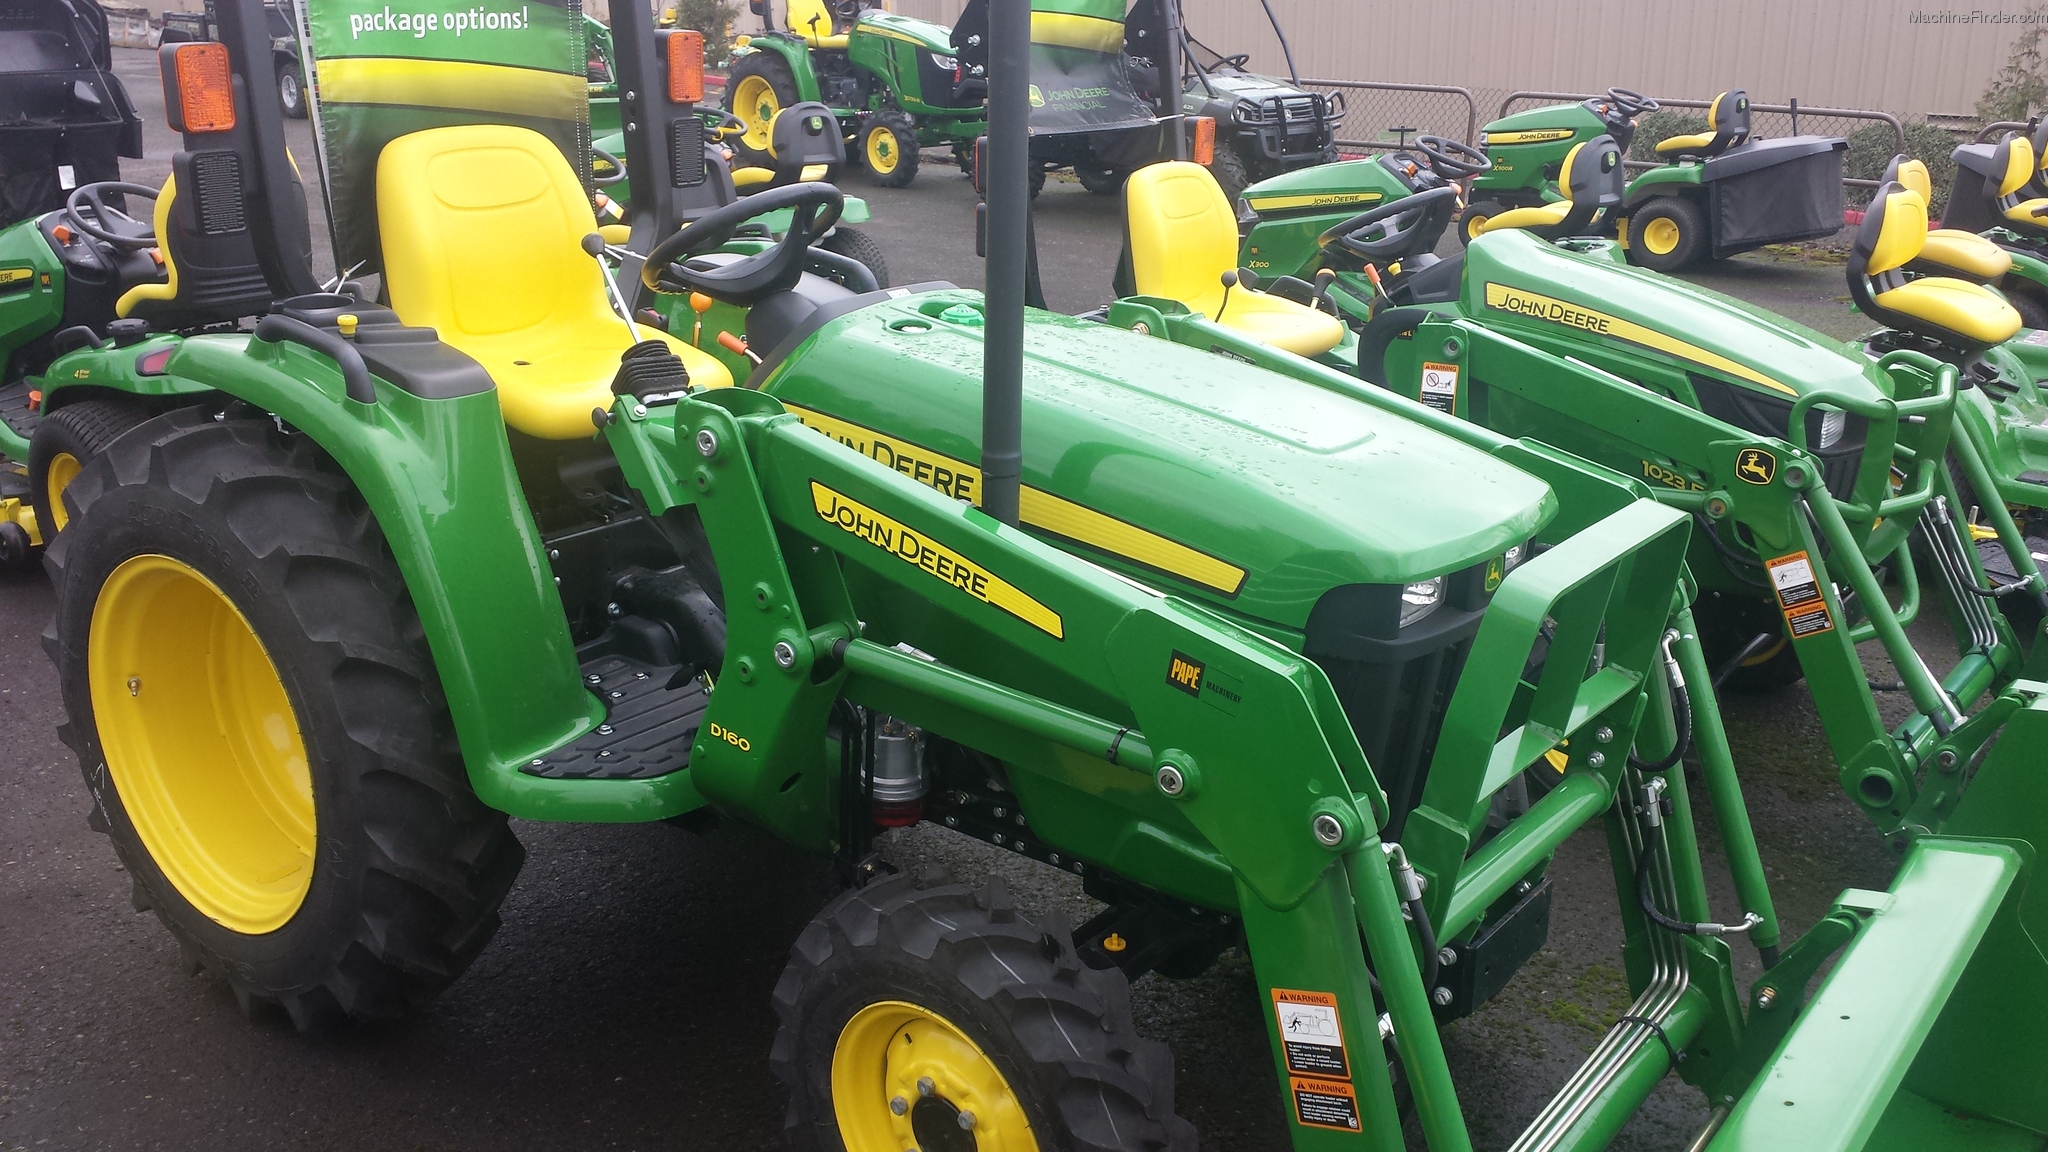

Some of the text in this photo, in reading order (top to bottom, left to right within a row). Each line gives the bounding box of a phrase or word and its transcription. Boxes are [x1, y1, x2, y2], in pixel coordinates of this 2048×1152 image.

[350, 5, 529, 40] package options!
[1048, 87, 1110, 101] JOHN DEERE
[1052, 100, 1106, 112] FINANCIAL
[1312, 195, 1360, 206] JOHN DEERE
[1248, 260, 1270, 268] X300
[1498, 294, 1611, 333] JOHN DEERE
[1430, 364, 1457, 372] WARNING
[821, 497, 989, 598] JOHN DEERE
[1777, 554, 1803, 564] WARNING
[1796, 604, 1822, 615] WARNING
[1205, 680, 1242, 704] MACHINERY
[710, 722, 751, 752] D160
[1289, 994, 1328, 1003] WARNING
[1308, 1082, 1347, 1094] WARNING
